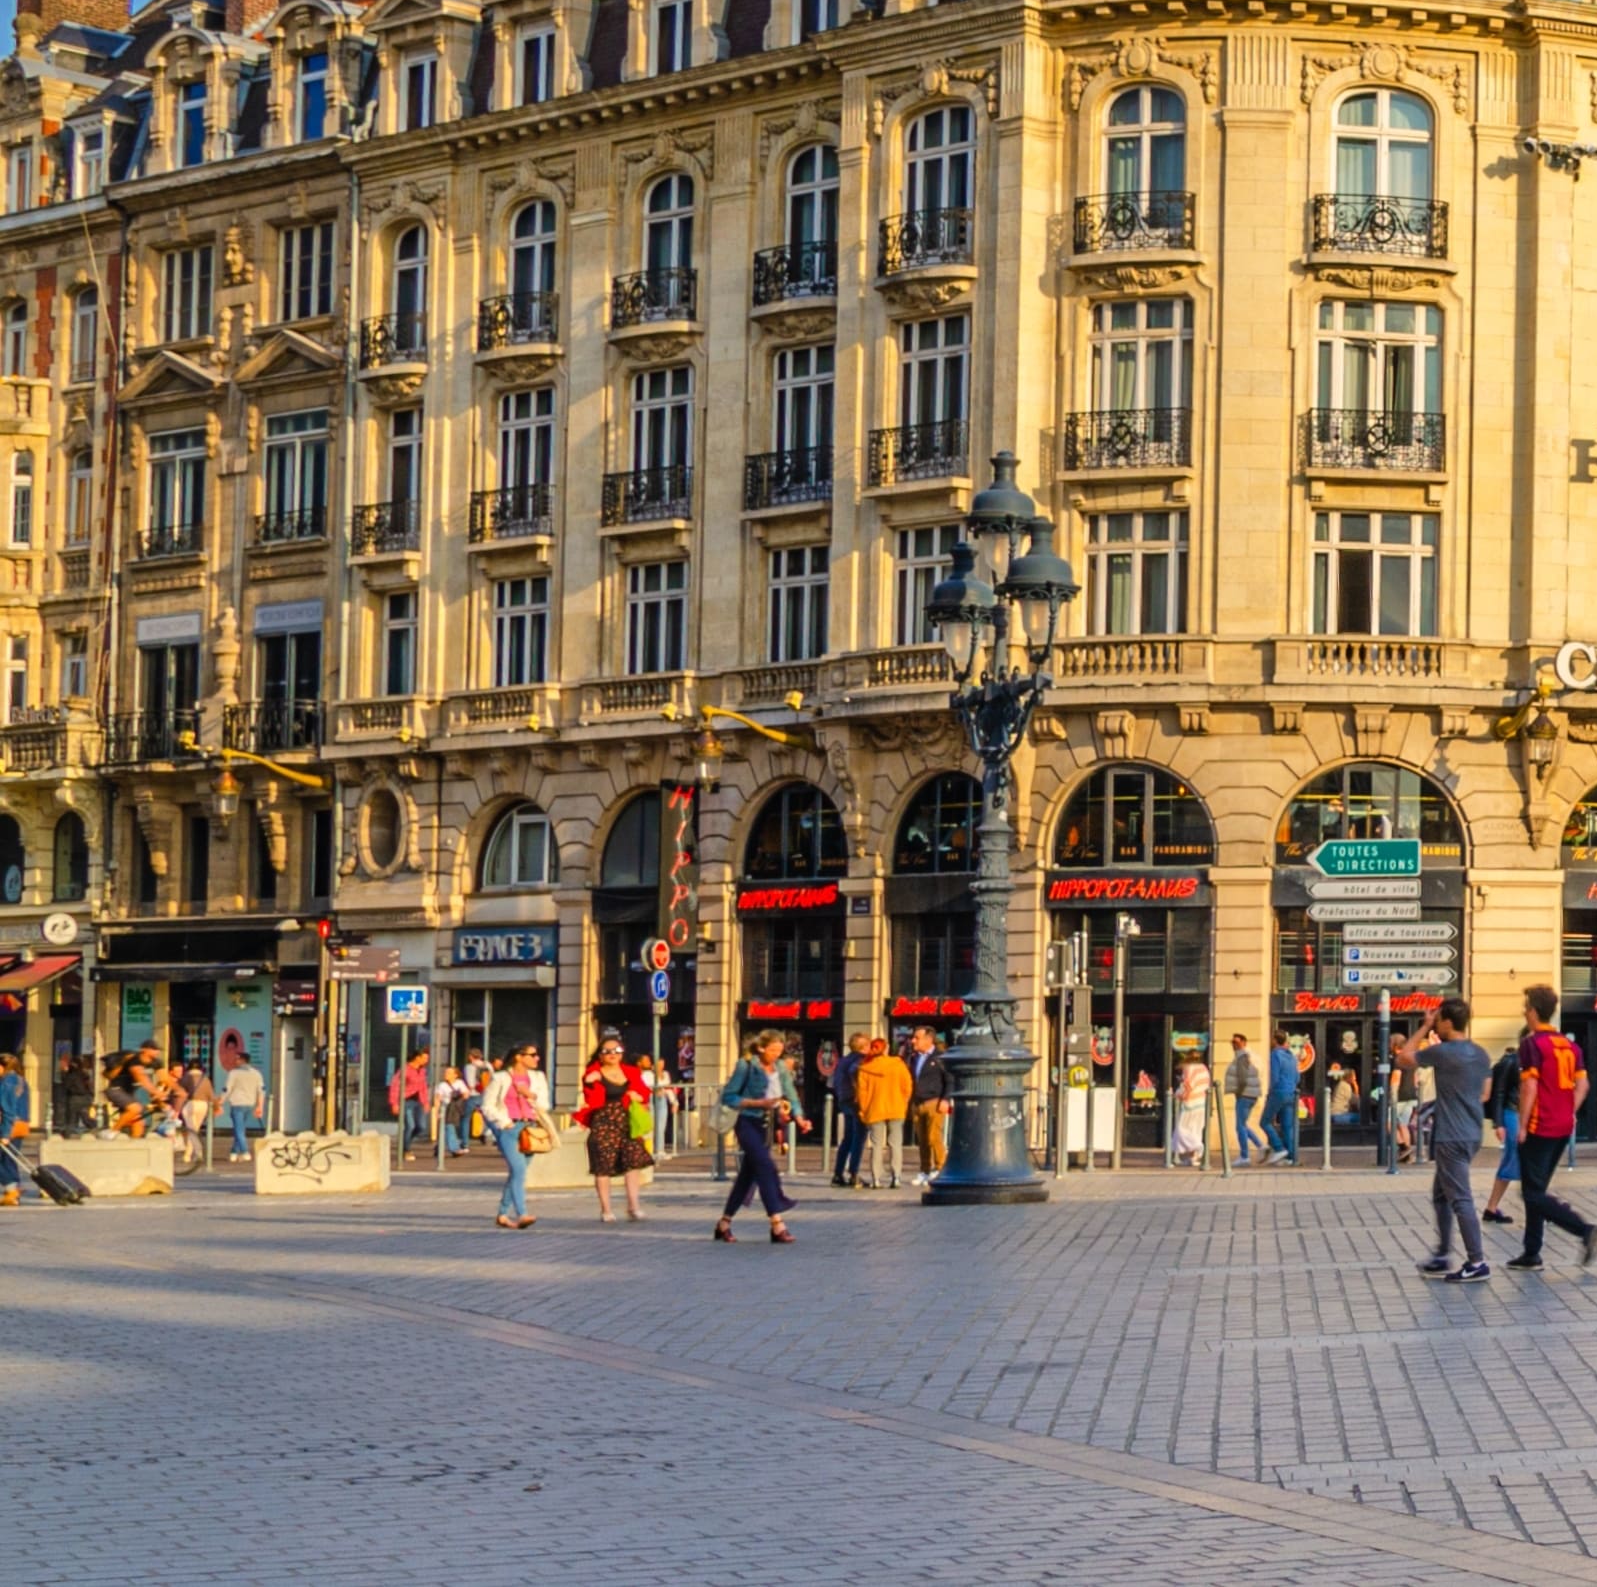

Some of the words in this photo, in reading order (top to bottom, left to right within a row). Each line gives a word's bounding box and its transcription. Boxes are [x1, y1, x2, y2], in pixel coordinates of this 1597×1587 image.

[1331, 845, 1379, 857] TOUTES
[668, 785, 696, 947] HIPPO
[1048, 877, 1199, 901] HIPPOPOTAMUS
[1344, 885, 1371, 894] hôtel
[1375, 885, 1387, 894] de
[1393, 884, 1415, 894] ville
[1318, 906, 1371, 916] Préfecture
[1376, 906, 1387, 915] du
[1392, 905, 1415, 915] Nord
[1349, 928, 1379, 937] office
[1384, 928, 1395, 937] de
[1400, 928, 1446, 937] tourisme
[1362, 950, 1406, 959] Nouveau
[1411, 949, 1443, 959] Siècle
[1362, 972, 1393, 981] Grand
[1294, 992, 1360, 1013] Service
